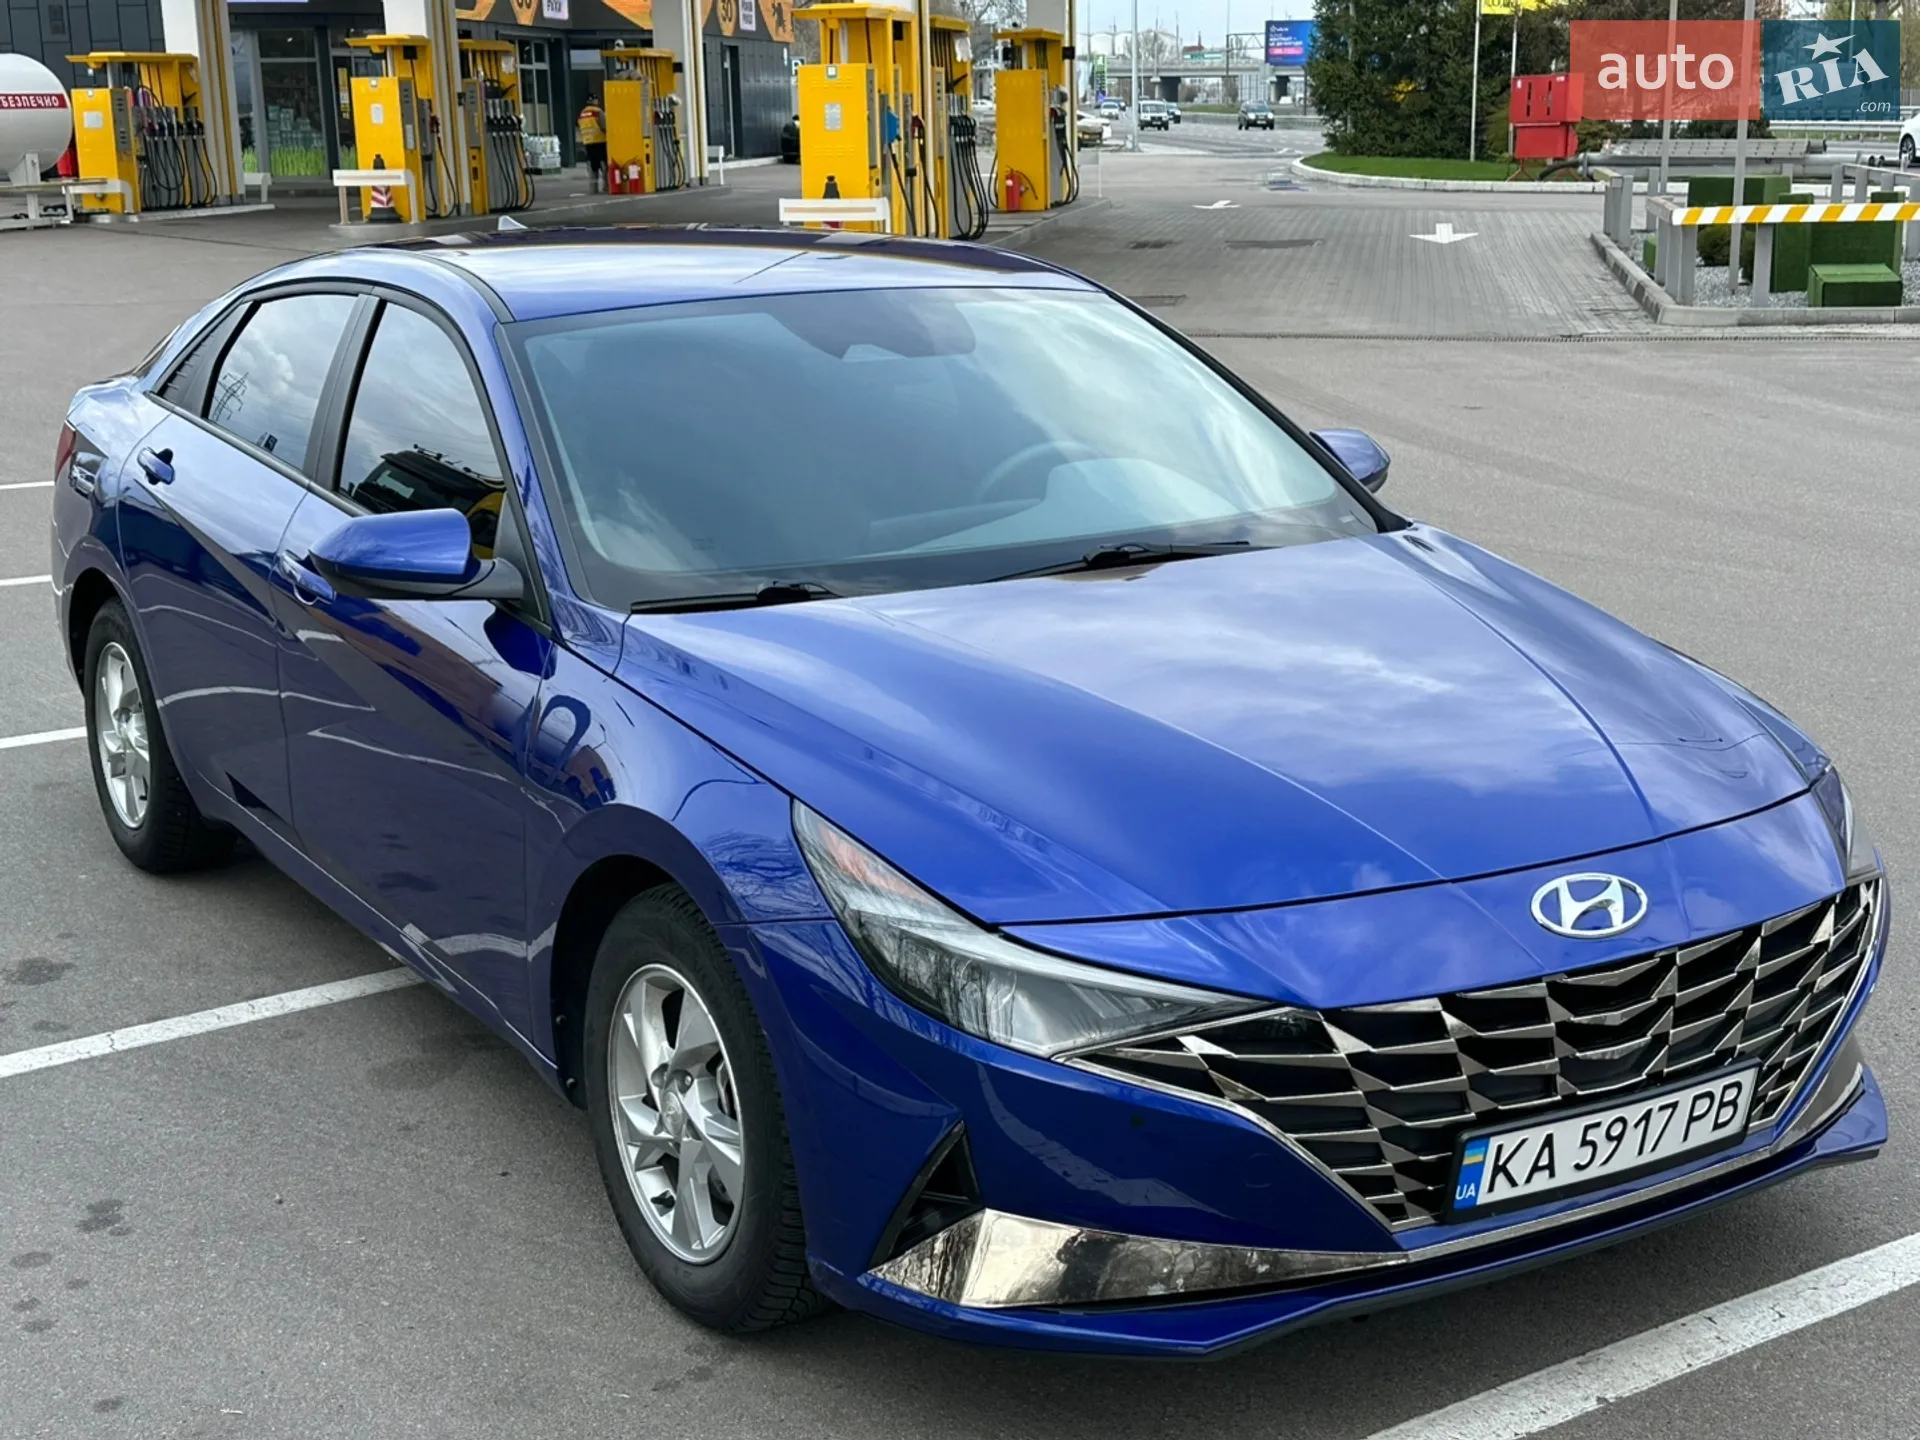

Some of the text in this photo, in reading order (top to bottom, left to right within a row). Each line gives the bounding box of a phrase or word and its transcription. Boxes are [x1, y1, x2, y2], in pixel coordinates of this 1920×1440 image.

[0, 95, 59, 107] БЕЗПЕЧНО
[1487, 1080, 1743, 1194] KA 5917 PB
[1456, 1182, 1476, 1200] UA
